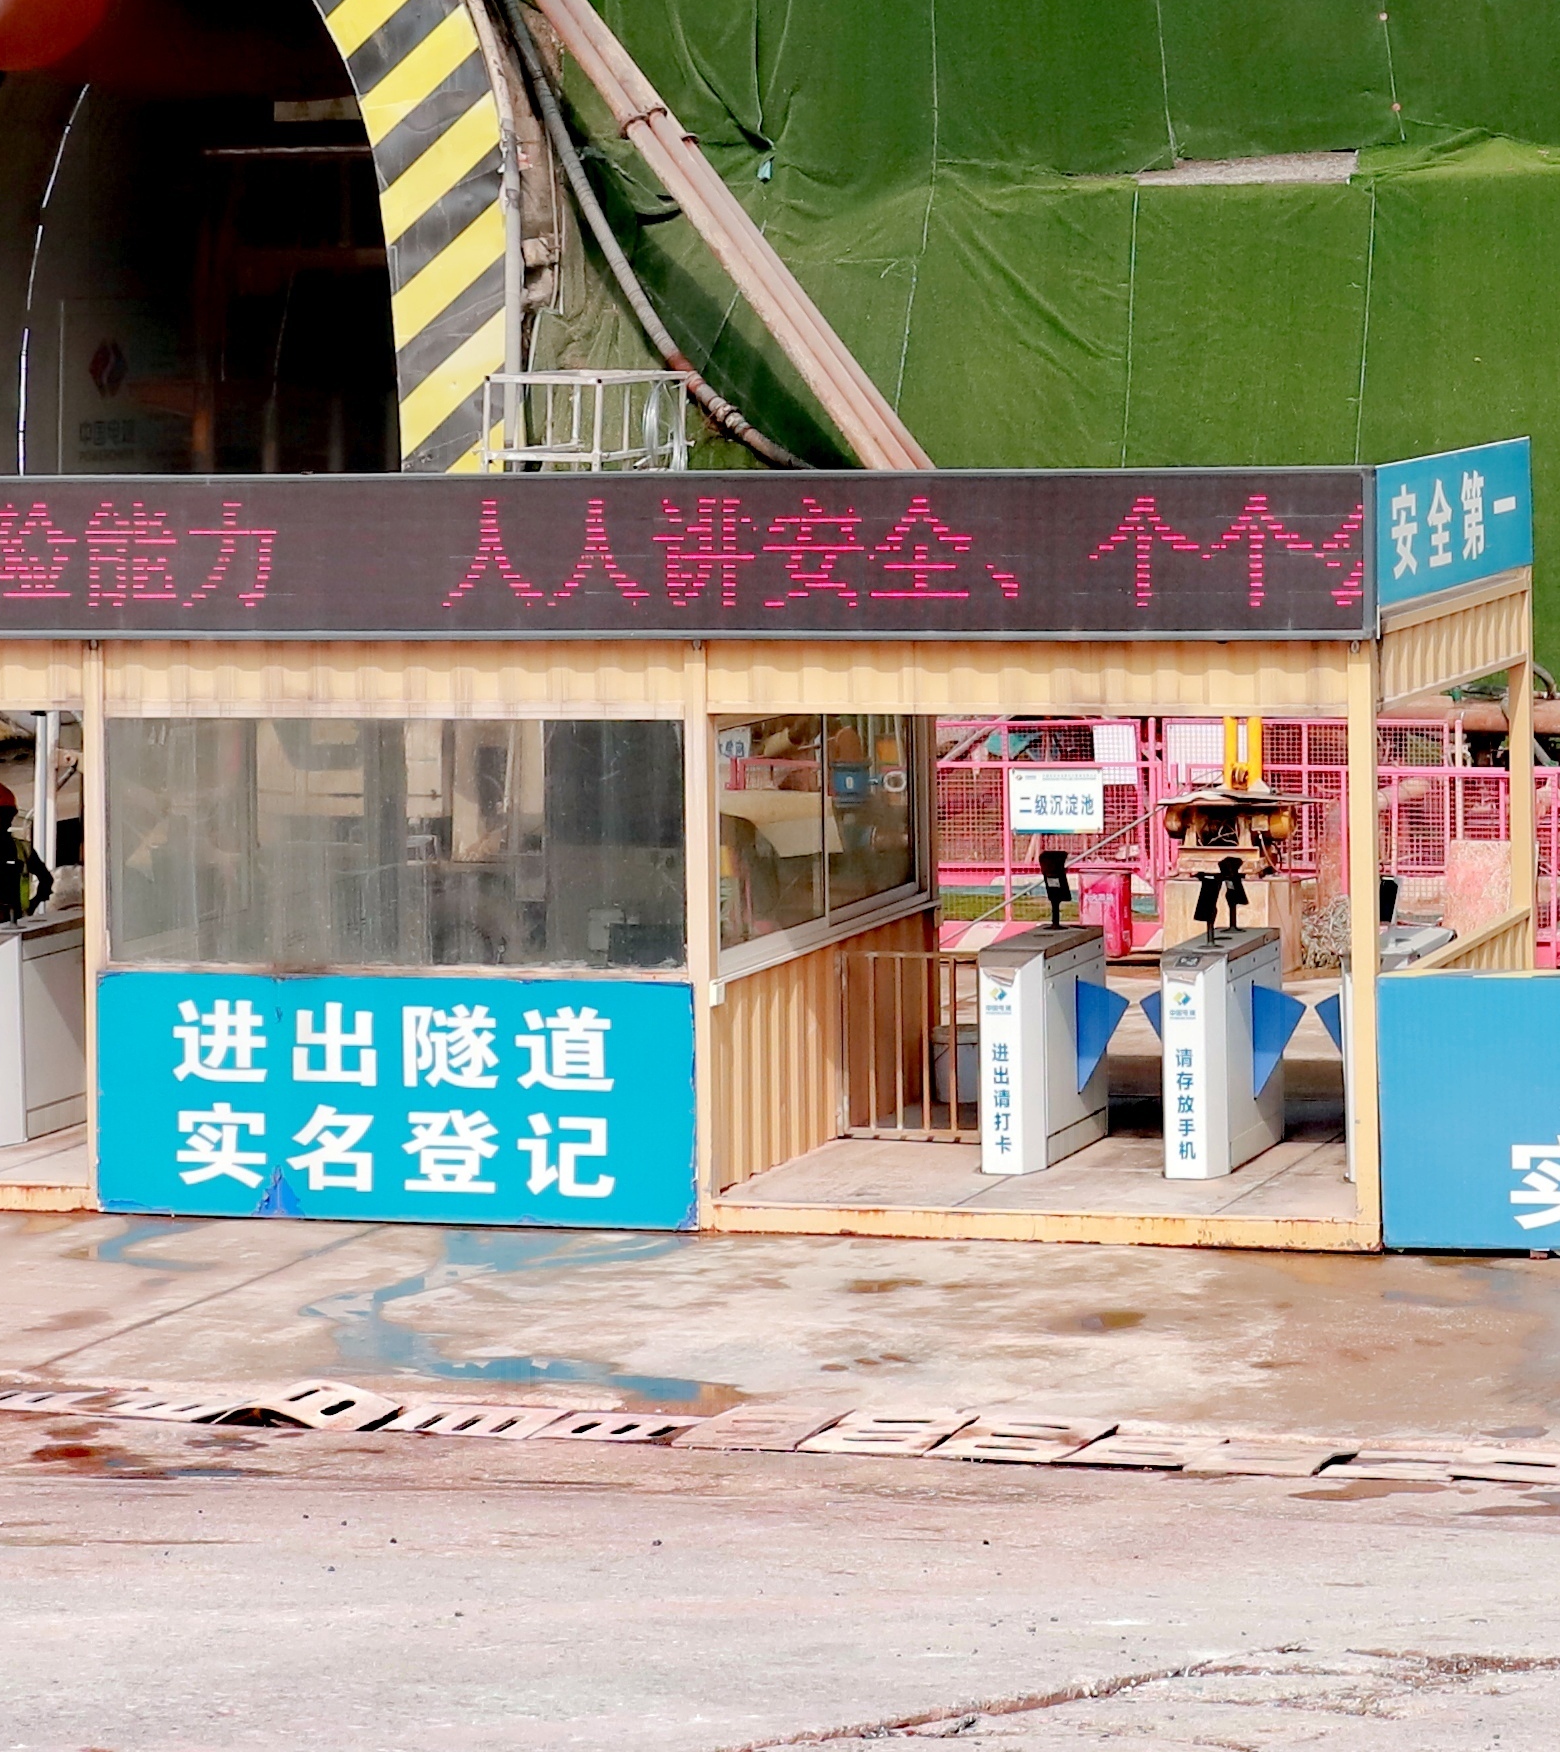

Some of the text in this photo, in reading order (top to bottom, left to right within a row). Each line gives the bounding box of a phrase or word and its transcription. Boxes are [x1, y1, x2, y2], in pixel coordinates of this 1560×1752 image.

[1391, 470, 1517, 580] 安全第一
[1019, 794, 1094, 816] 二级沉淀池
[172, 999, 615, 1092] 进出隧道
[176, 1102, 616, 1198] 实名登记
[992, 1043, 1012, 1154] 进出请打卡
[1175, 1048, 1196, 1160] 请存放手机
